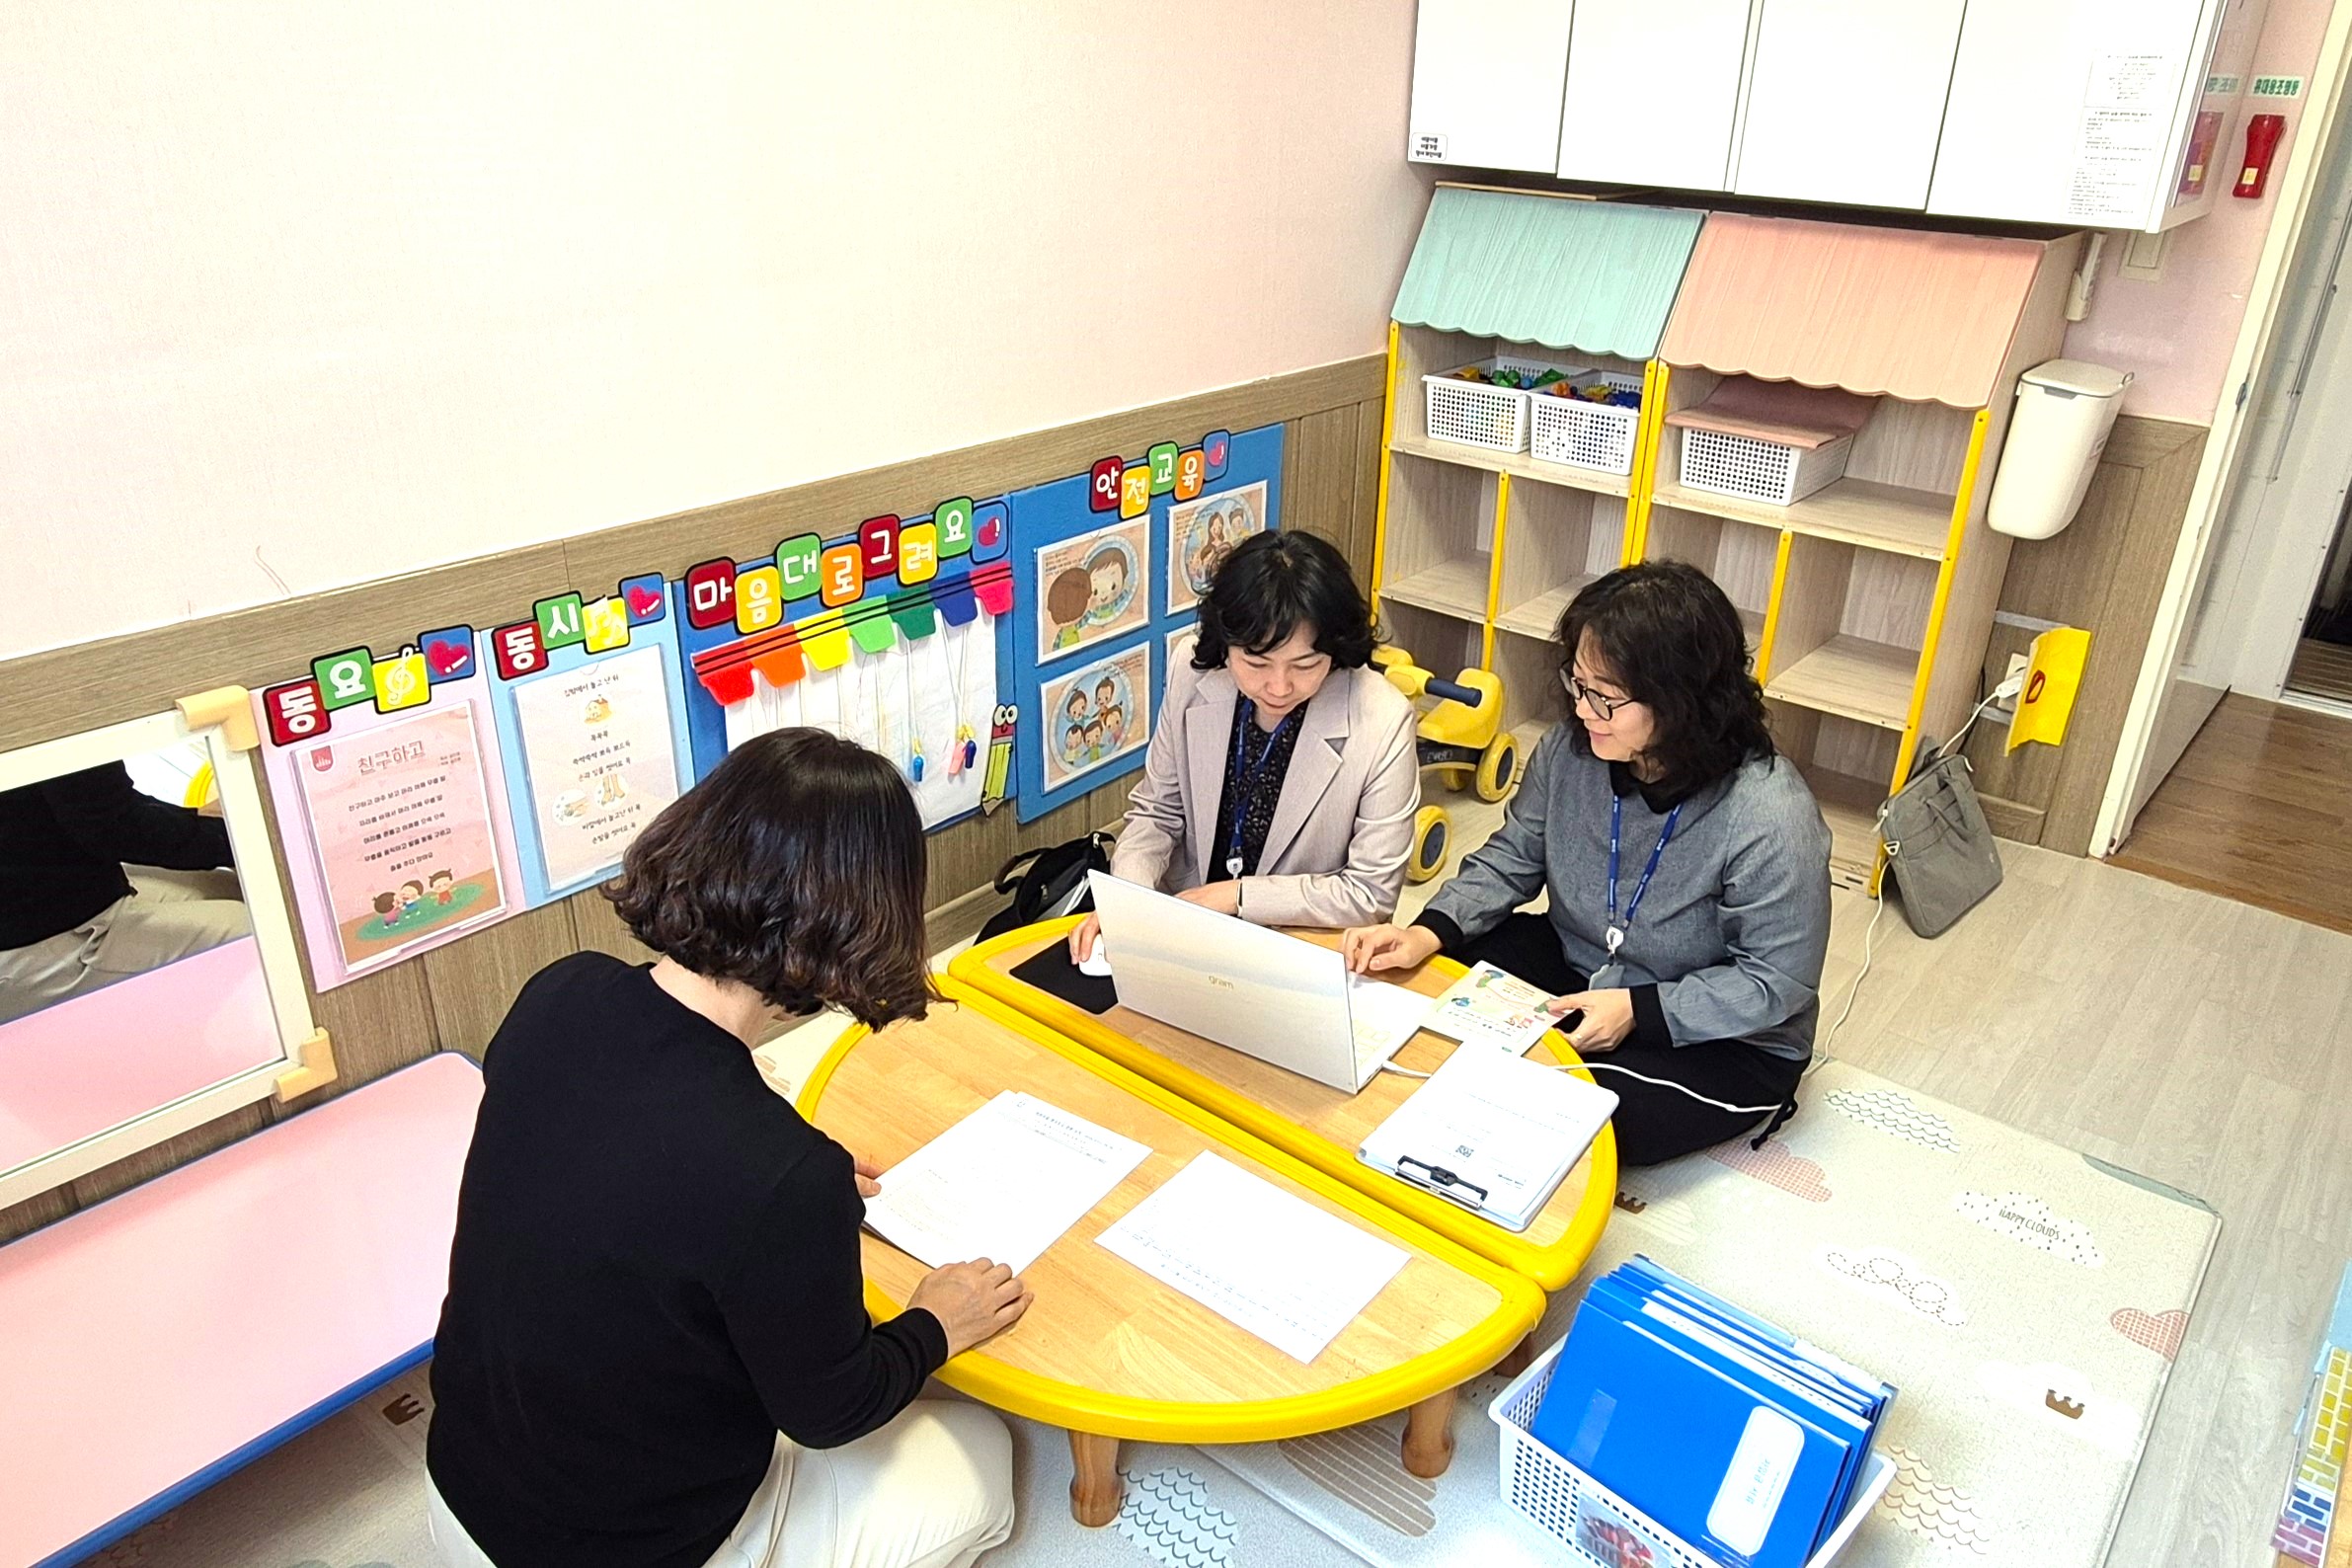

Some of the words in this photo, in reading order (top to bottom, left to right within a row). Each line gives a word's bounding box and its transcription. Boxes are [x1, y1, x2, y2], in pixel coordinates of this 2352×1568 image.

[1096, 453, 1198, 506] 안전교육
[505, 602, 580, 670] 동시
[278, 660, 367, 734] 동요
[357, 741, 426, 776] 친구하고
[1208, 975, 1234, 990] gram
[1999, 1209, 2025, 1225] HAPPY
[2025, 1218, 2060, 1240] CLOUDS
